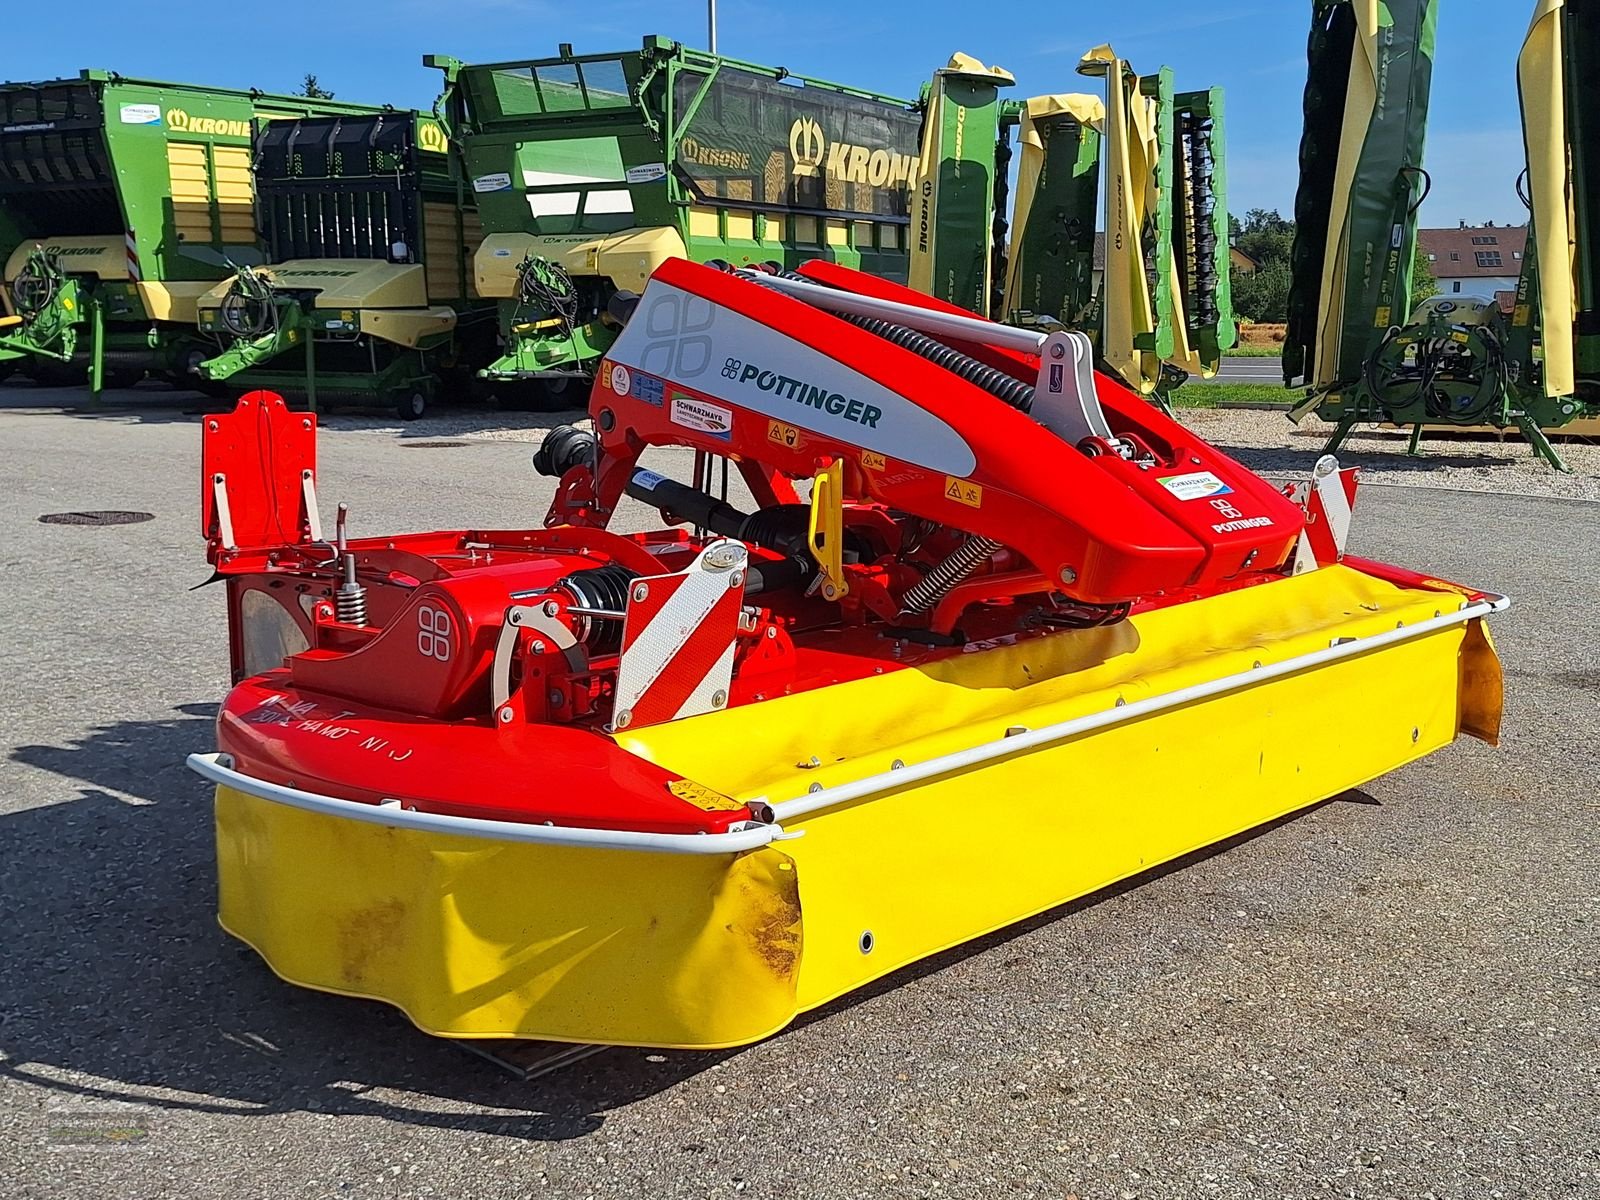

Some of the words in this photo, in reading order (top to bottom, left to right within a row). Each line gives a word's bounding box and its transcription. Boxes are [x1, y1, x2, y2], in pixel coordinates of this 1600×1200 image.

[189, 117, 250, 136] KRONE
[919, 199, 929, 253] KRONE
[1388, 250, 1398, 274] EASY
[1518, 275, 1529, 300] EASY
[676, 400, 723, 422] SCHWARZMAYR
